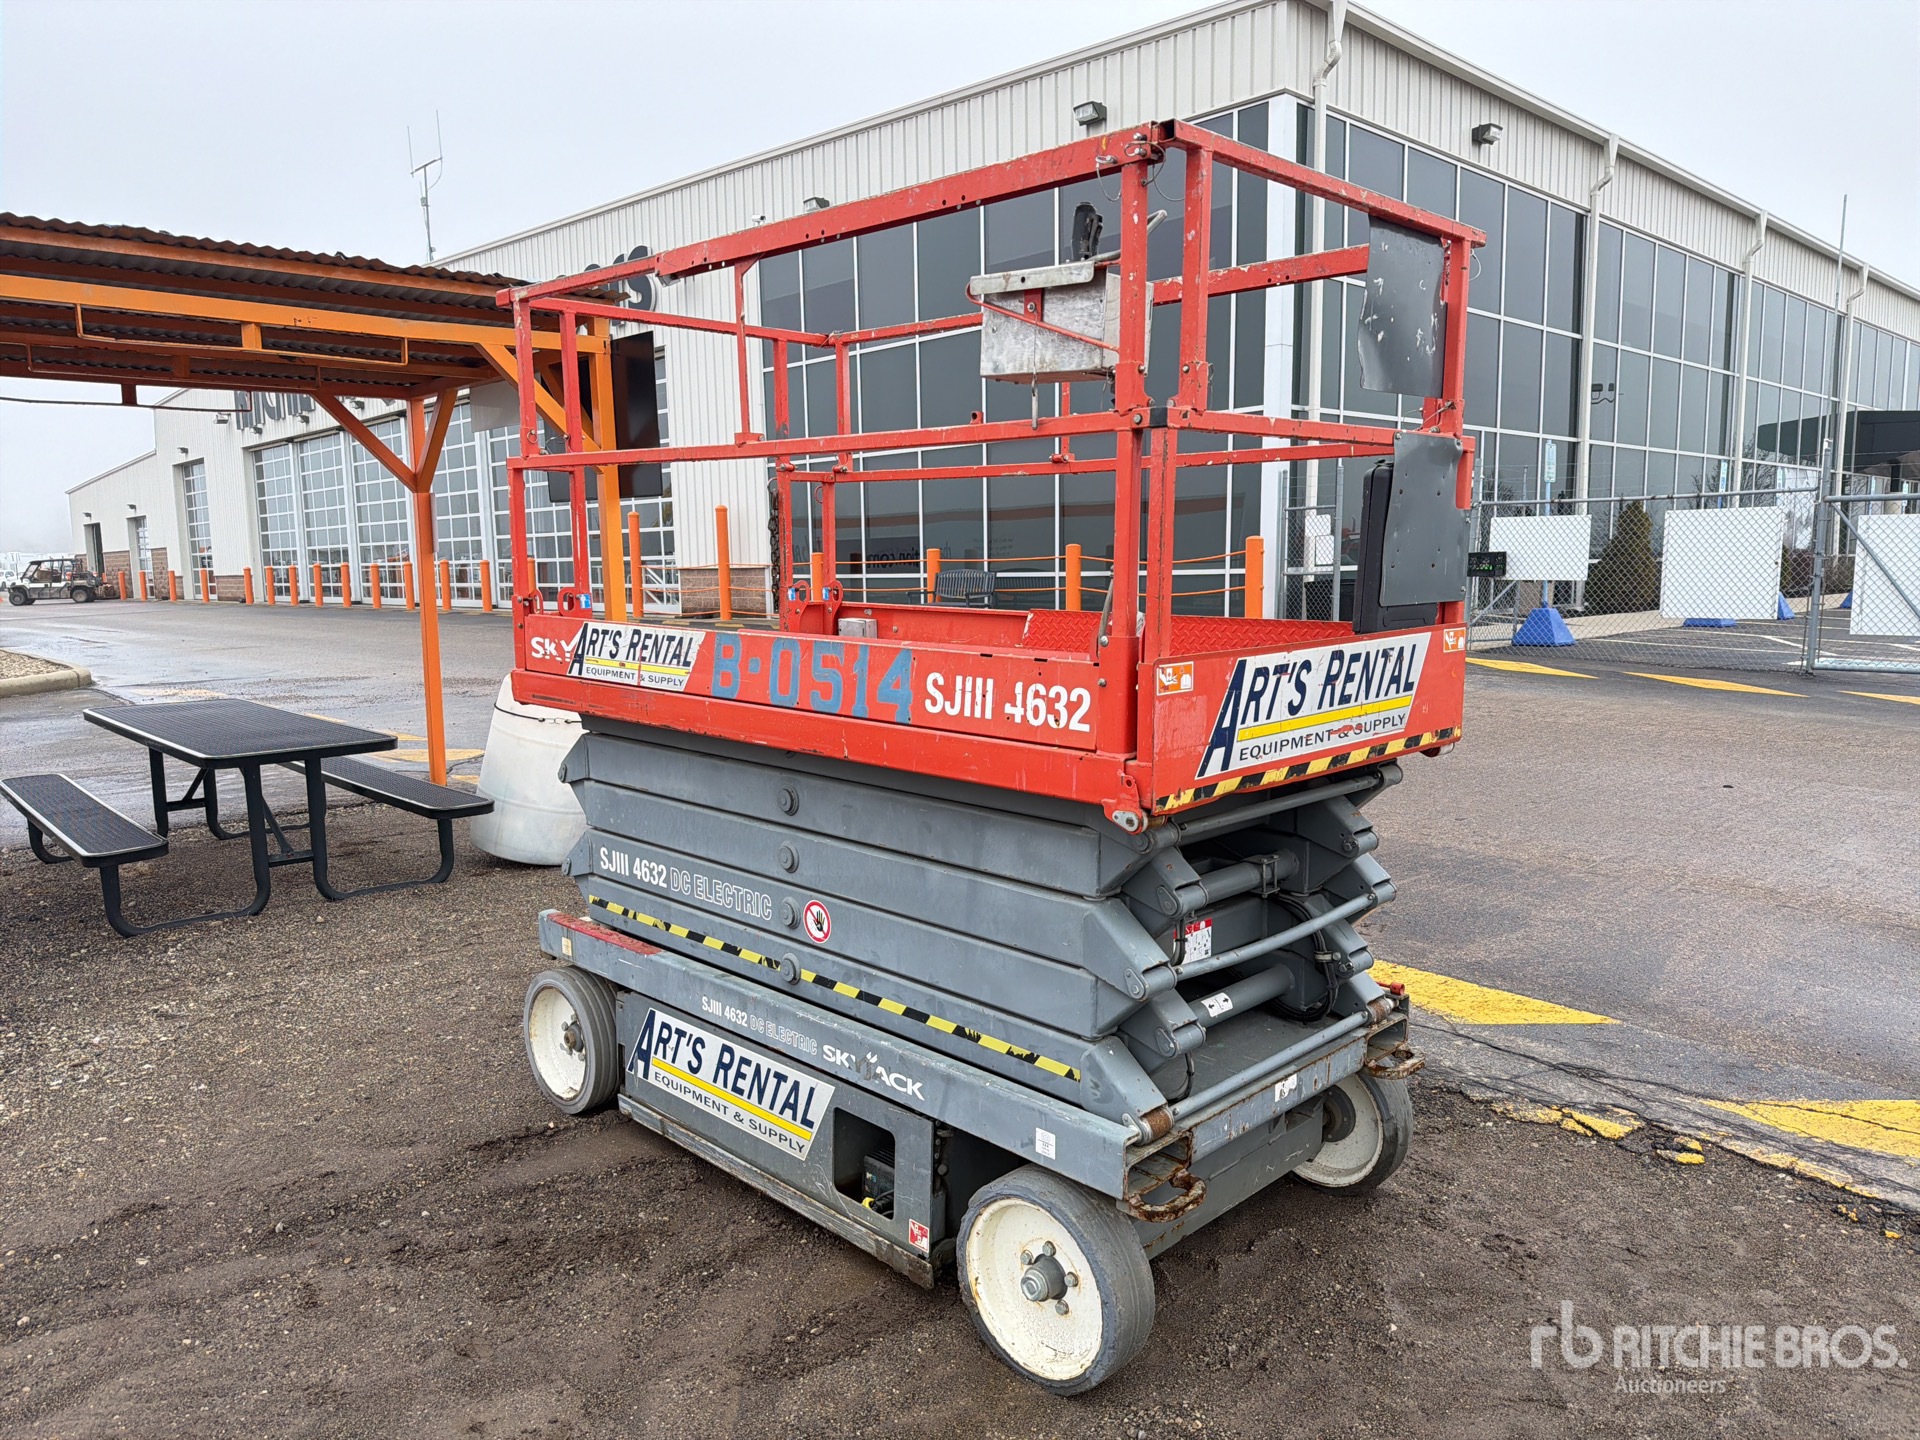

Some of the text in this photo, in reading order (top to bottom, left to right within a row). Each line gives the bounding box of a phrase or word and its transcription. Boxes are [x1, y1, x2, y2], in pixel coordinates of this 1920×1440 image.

[568, 622, 695, 676] ART'S RENTAL
[586, 666, 684, 687] EQUIPMENT & SUPPLY
[924, 672, 1092, 733] SJIII 4632
[1196, 643, 1417, 778] ART'S RENTAL
[1239, 712, 1406, 762] EQUIPMENT & SUPPLY
[600, 847, 772, 921] SJIII 4632 DC ELECTRIC
[702, 996, 722, 1018] SJIII
[724, 1004, 748, 1028] 4632
[750, 1014, 765, 1034] DC
[766, 1022, 818, 1056] ELECTRIC
[628, 1009, 816, 1130] ART'S RENTAL
[654, 1071, 806, 1154] EQUIPMENT & SUPPLY
